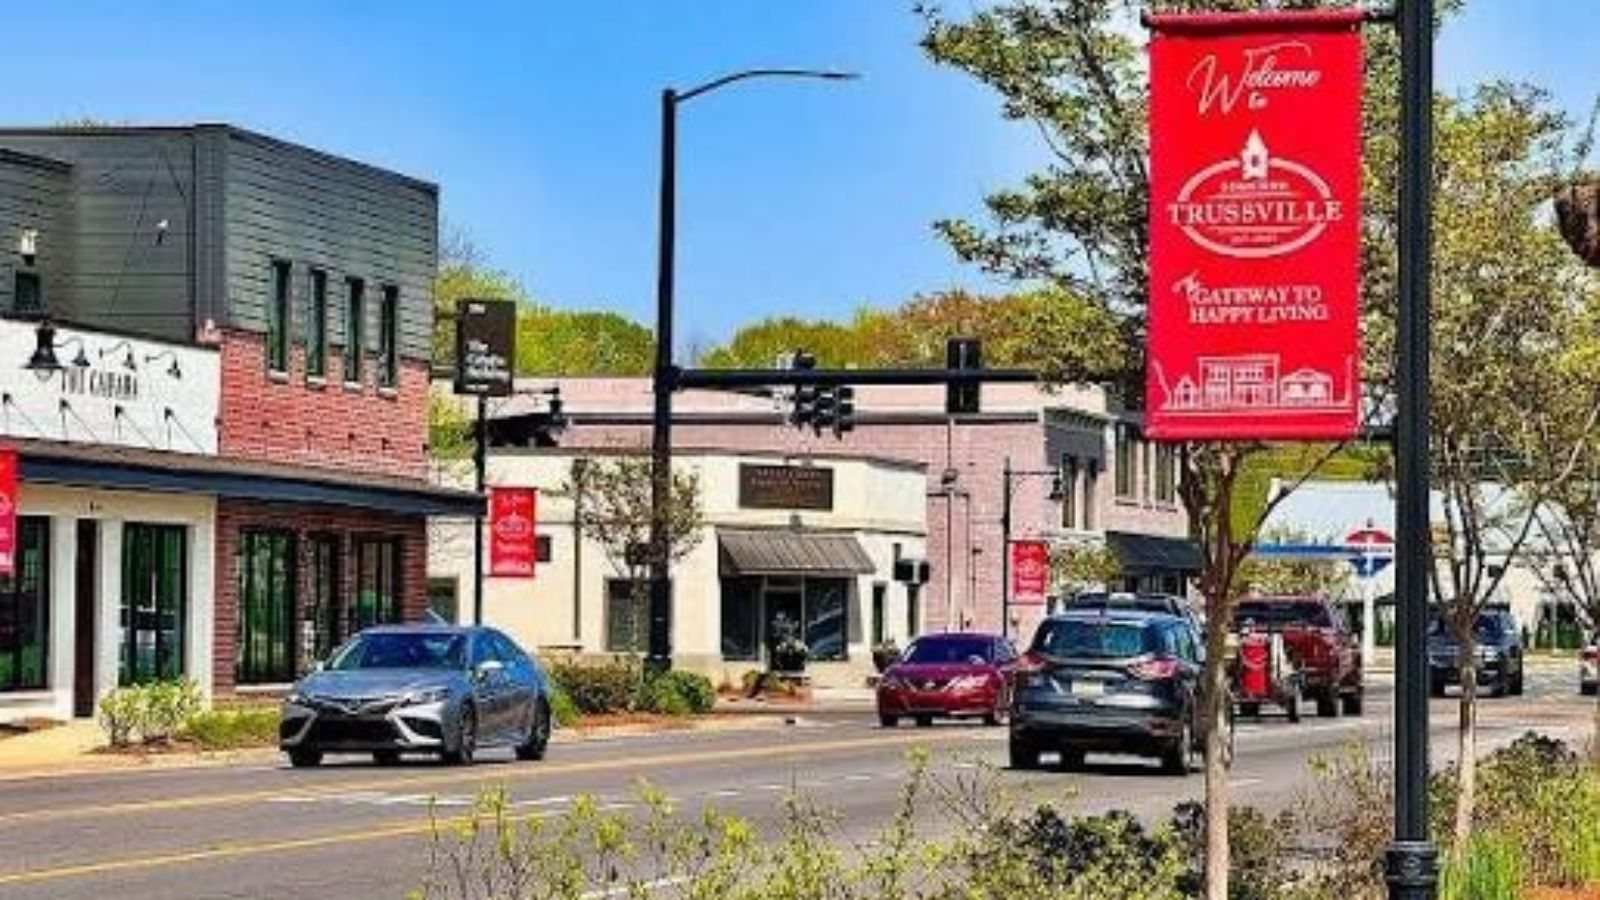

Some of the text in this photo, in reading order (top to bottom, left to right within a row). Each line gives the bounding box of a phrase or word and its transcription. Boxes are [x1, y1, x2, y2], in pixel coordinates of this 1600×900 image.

[1186, 40, 1321, 115] Welcome
[1167, 200, 1343, 225] TRUSSVILLE
[1194, 286, 1291, 305] GATEWAY
[1292, 284, 1322, 302] TO
[1189, 303, 1330, 323] HAPPY LIVING
